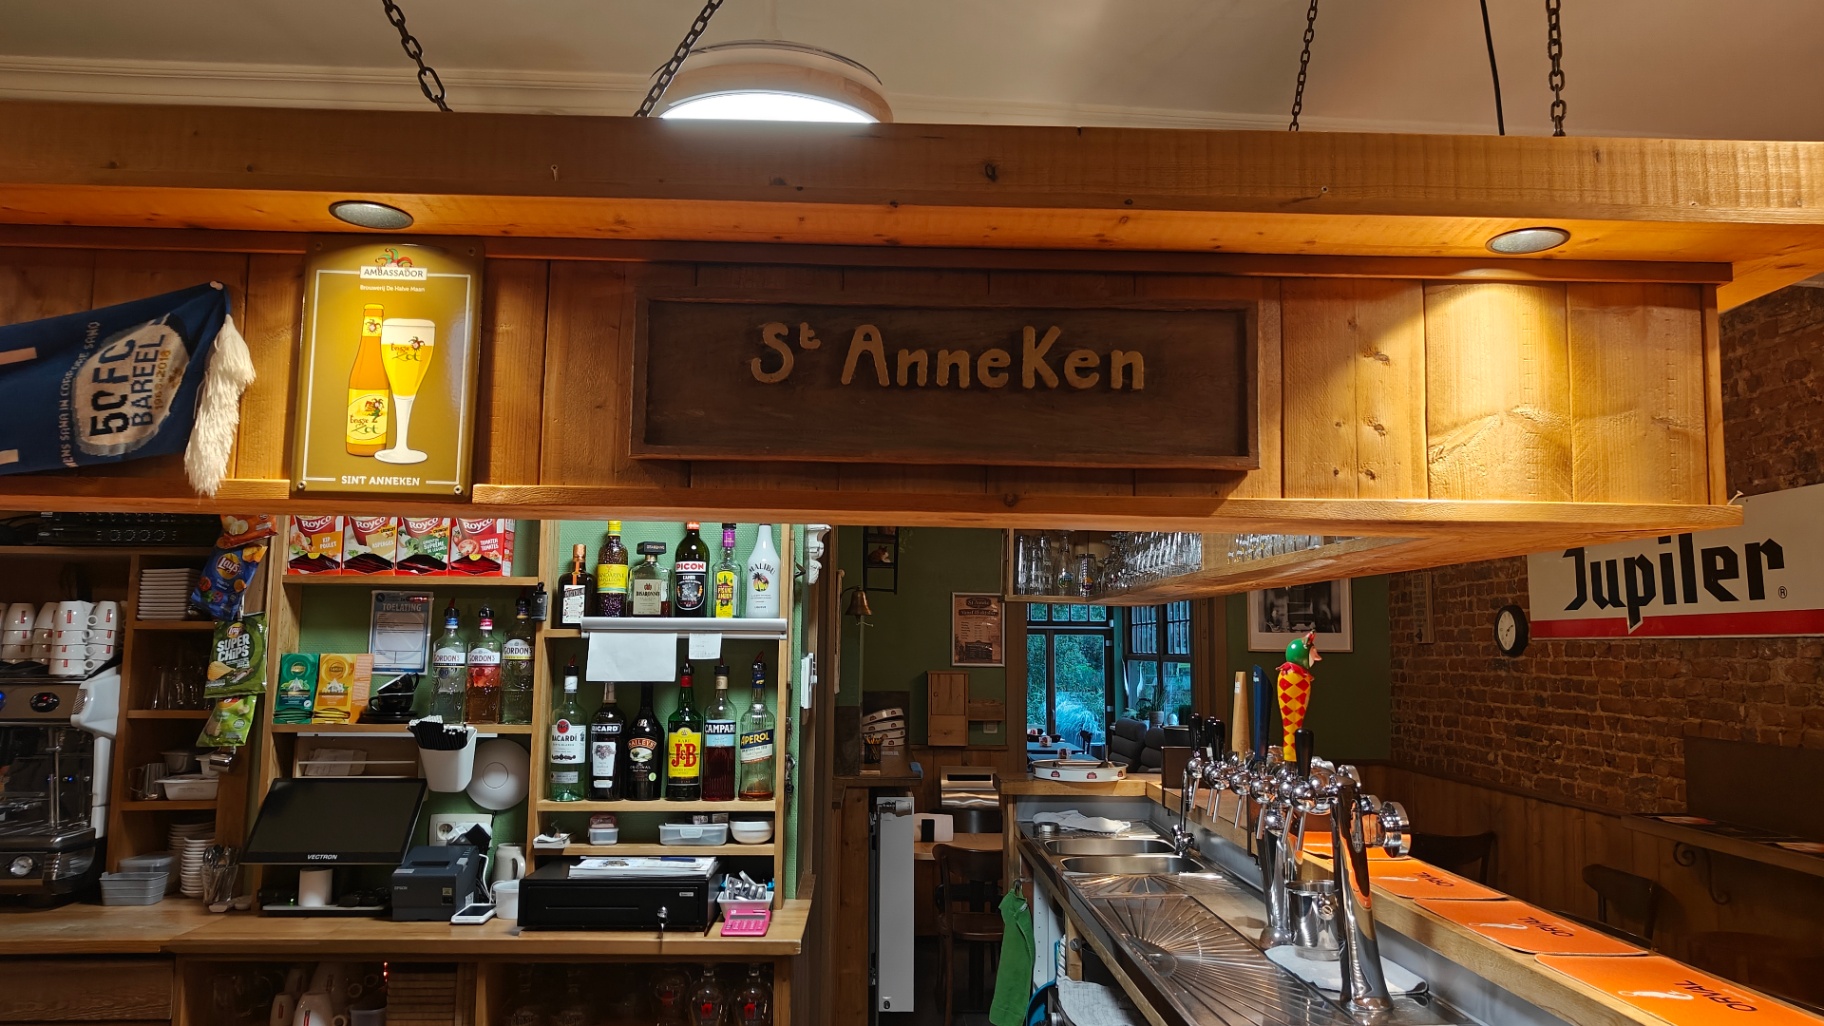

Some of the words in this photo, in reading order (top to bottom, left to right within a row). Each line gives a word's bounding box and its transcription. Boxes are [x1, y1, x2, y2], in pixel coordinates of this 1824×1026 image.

[364, 268, 424, 278] AMBASSADOR
[360, 284, 386, 292] Brouwerij
[85, 321, 101, 349] SANO
[392, 351, 422, 362] Zot
[751, 322, 821, 384] St
[841, 324, 1145, 390] AnneKen
[131, 334, 166, 427] BAREEL
[59, 400, 70, 411] IN
[59, 413, 71, 441] SANA
[351, 424, 380, 434] Zot
[341, 475, 367, 485] SINT
[369, 476, 420, 486] ANNEKEN
[301, 516, 332, 529] Royco
[356, 516, 386, 529] Royco
[409, 517, 439, 530] Royco
[463, 517, 493, 530] Royco
[749, 562, 776, 576] MALIBU
[1563, 532, 1785, 630] Jupiler
[383, 603, 422, 611] TOELATING
[216, 633, 250, 652] SUPER
[503, 646, 533, 655] GORDON'S
[705, 724, 736, 733] CAMPARI
[741, 732, 770, 746] APEROL
[671, 743, 697, 768] J&B
[1518, 916, 1574, 938] ORVAL
[1674, 979, 1758, 1013] ORVAL
